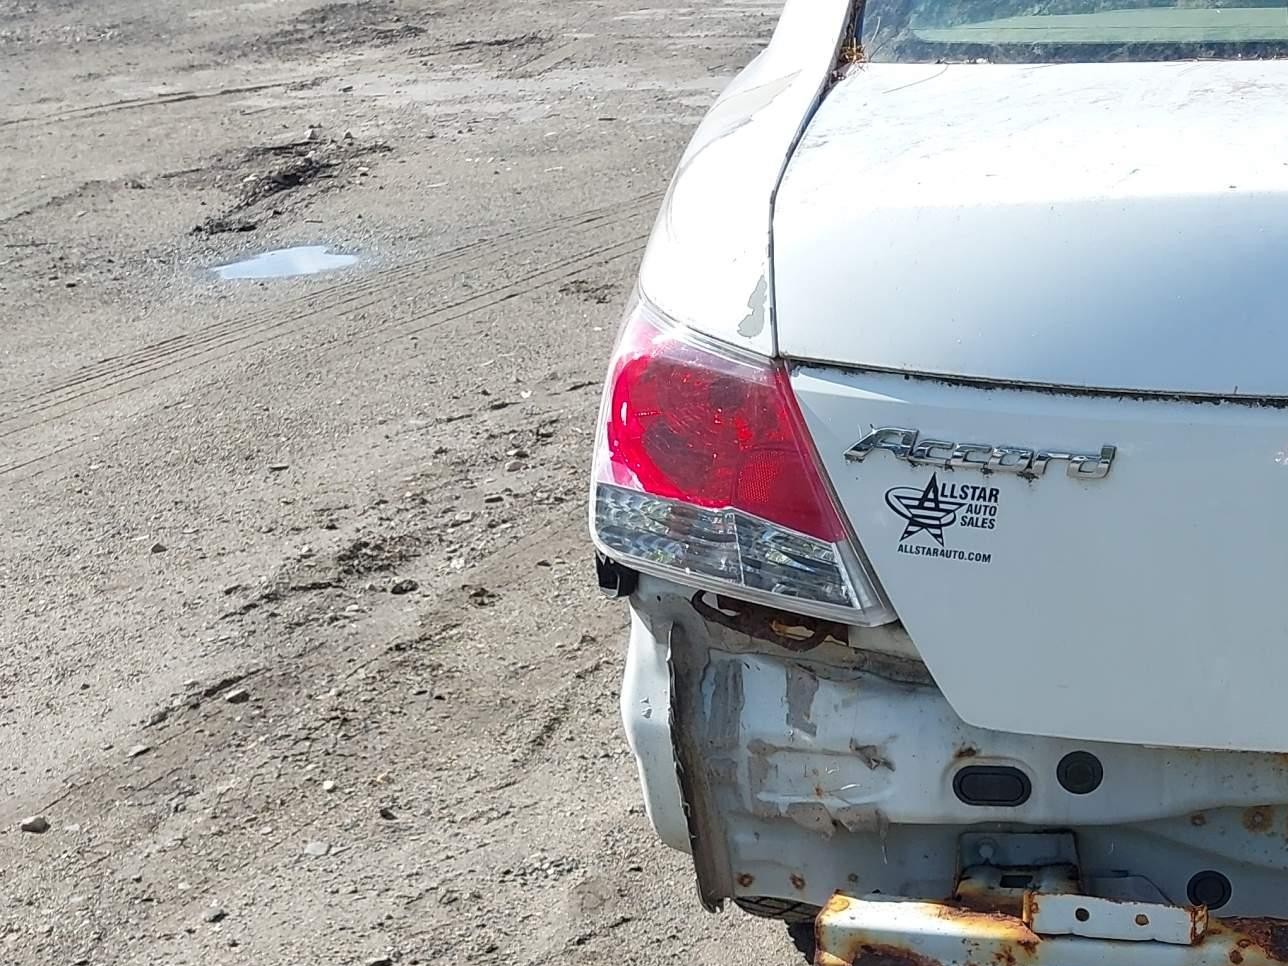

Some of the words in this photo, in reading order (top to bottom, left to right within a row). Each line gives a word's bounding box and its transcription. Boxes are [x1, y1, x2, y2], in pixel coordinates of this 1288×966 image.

[844, 426, 1117, 478] Accord
[919, 473, 999, 508] ALLSTAR
[965, 503, 998, 517] AUTO
[960, 515, 996, 530] SALES
[897, 543, 992, 563] ALLSTARAUTO.COM
